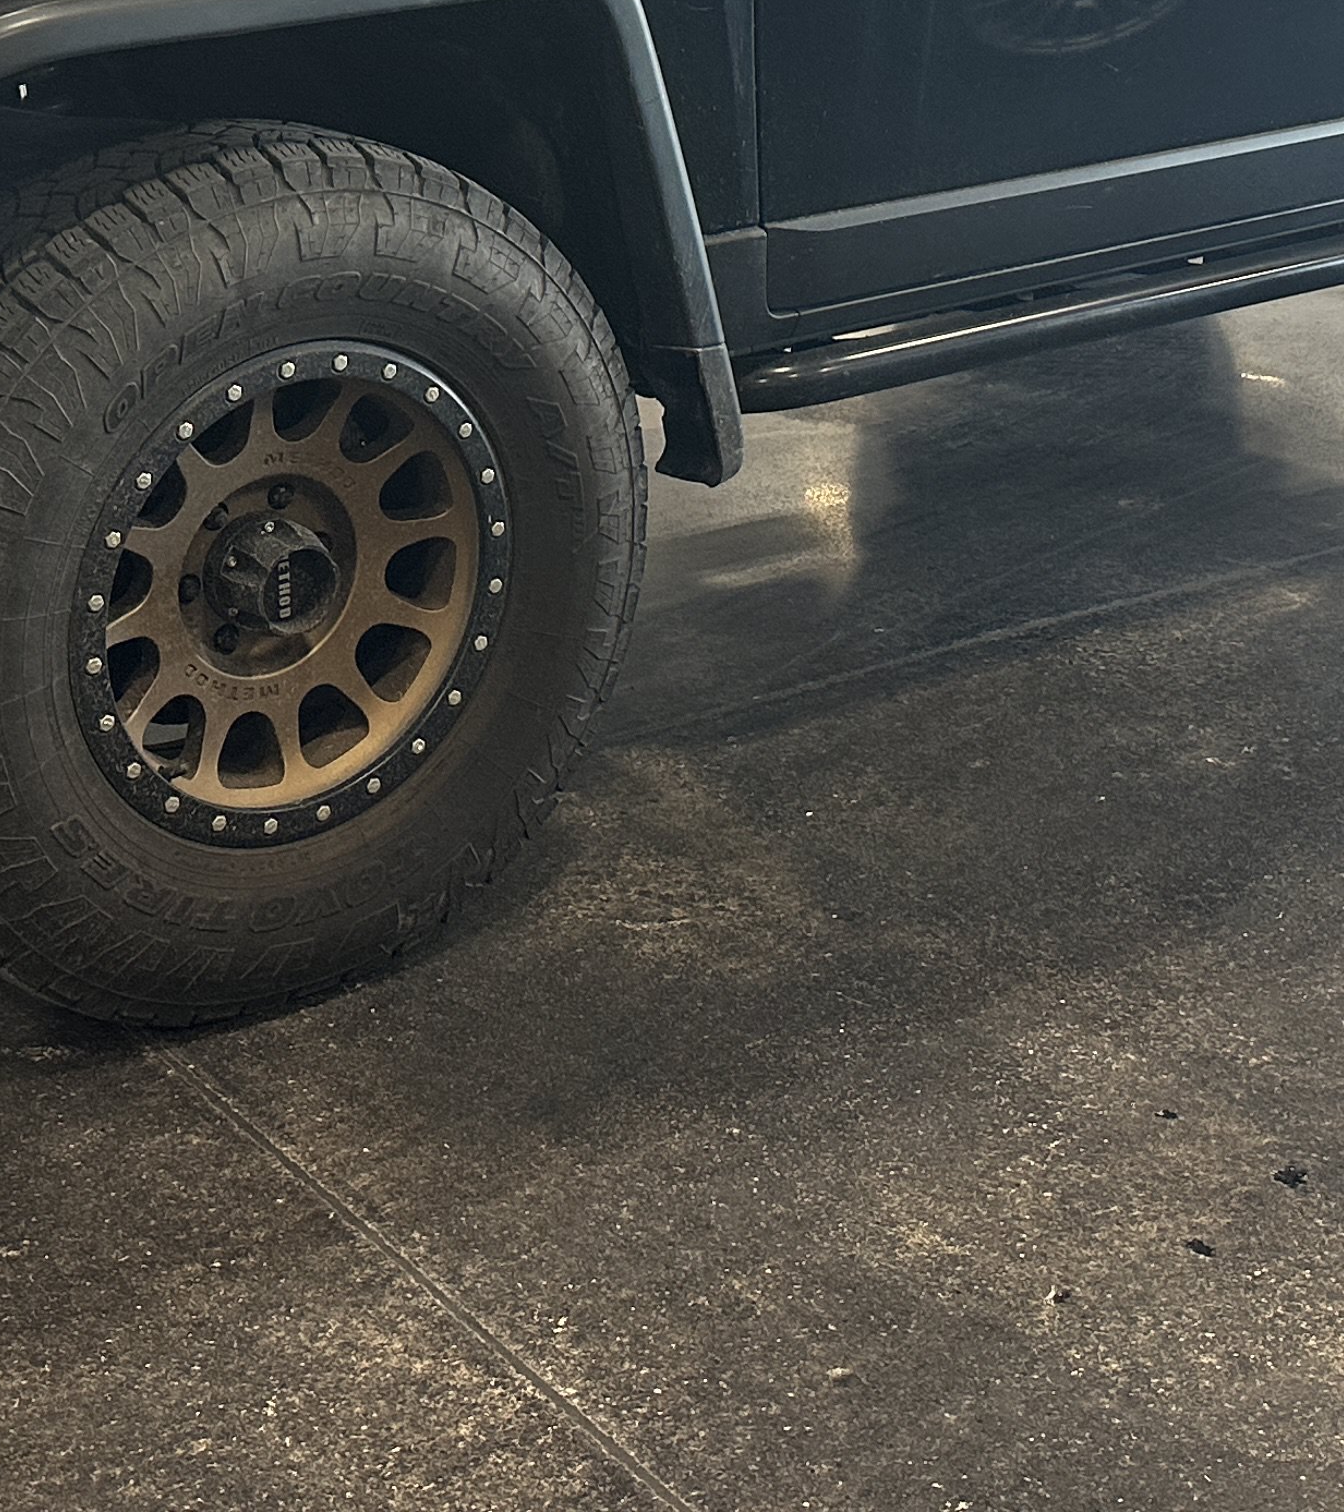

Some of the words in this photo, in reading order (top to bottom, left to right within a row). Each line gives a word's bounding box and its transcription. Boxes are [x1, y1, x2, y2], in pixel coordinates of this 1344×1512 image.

[104, 288, 267, 434] OPEN
[275, 271, 539, 371] COUNTRY
[183, 662, 281, 702] METHOD
[50, 814, 238, 933] TIRES
